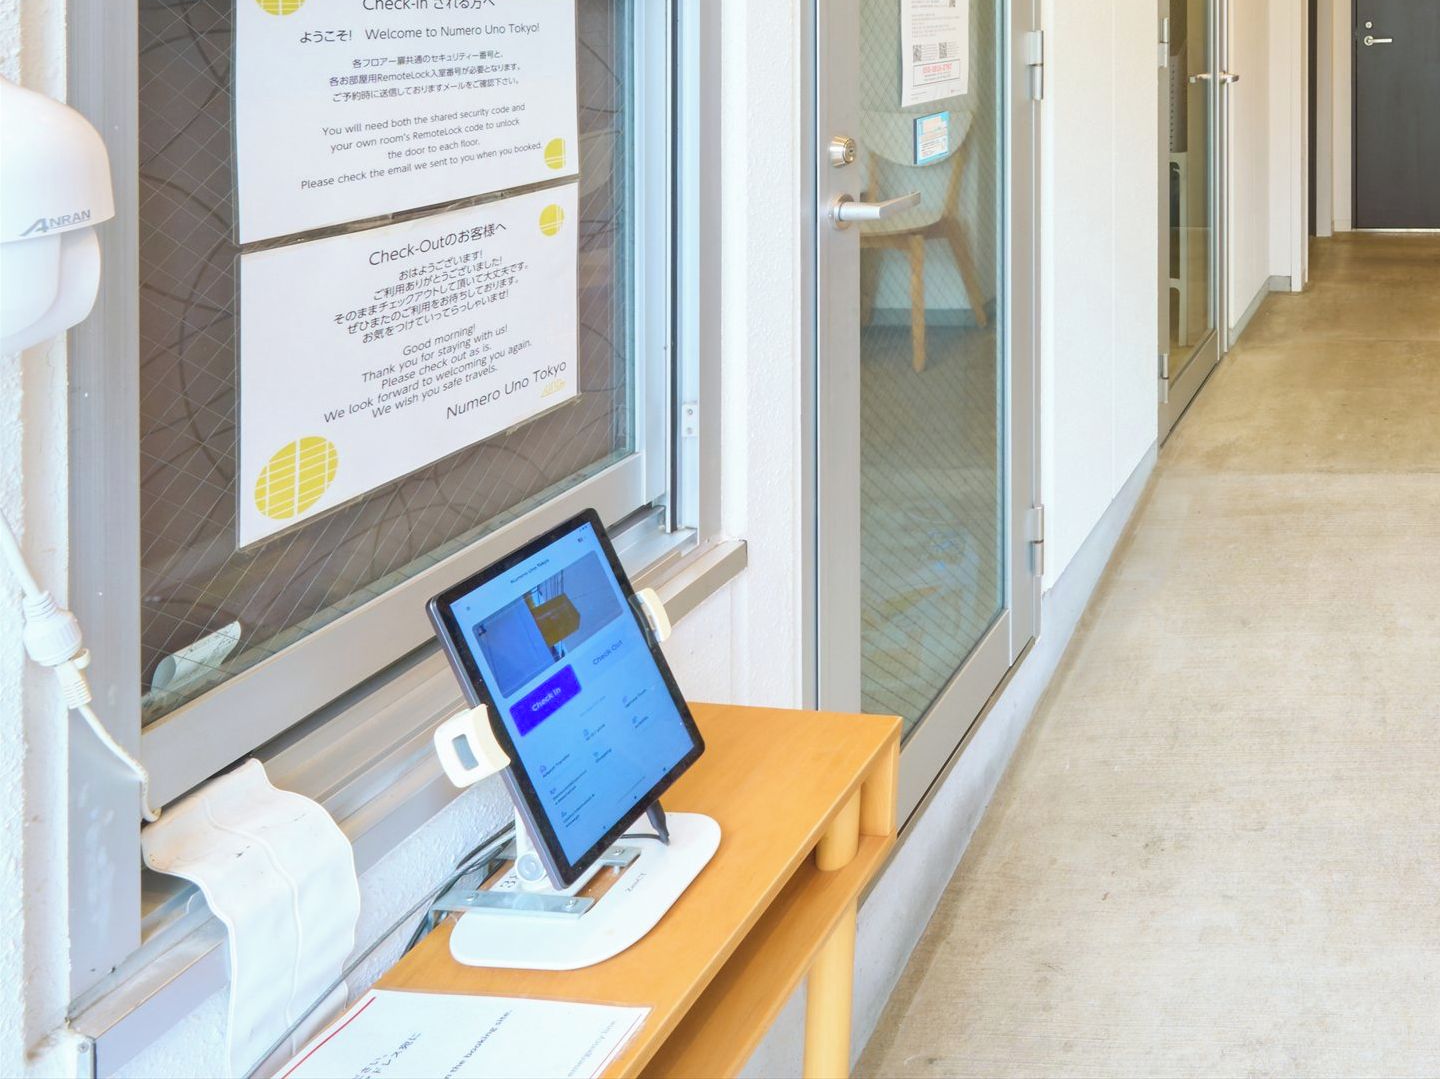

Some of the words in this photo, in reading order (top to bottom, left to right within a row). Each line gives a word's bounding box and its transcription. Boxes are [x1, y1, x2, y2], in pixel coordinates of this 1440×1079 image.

[300, 30, 351, 43] ようこそ!
[365, 28, 422, 39] Welcome
[426, 28, 437, 37] to
[441, 27, 482, 36] Numero
[485, 25, 505, 34] Uno
[509, 23, 539, 35] Tokyo!
[331, 142, 353, 153] your
[356, 139, 376, 148] own
[380, 133, 410, 144] room's
[413, 126, 463, 140] RemoteLock
[465, 124, 483, 134] code
[496, 118, 519, 127] unlock
[345, 123, 362, 133] will
[365, 120, 388, 130] need
[391, 118, 411, 127] both
[430, 112, 458, 122] shared
[459, 109, 489, 118] security
[491, 106, 509, 114] code
[512, 104, 525, 112] and
[301, 176, 335, 189] Please
[337, 171, 367, 183] check
[370, 169, 384, 178] the
[388, 164, 411, 175] email
[414, 162, 427, 170] we
[430, 158, 447, 167] sent
[460, 155, 474, 164] you
[476, 151, 497, 159] when
[499, 149, 512, 157] you
[514, 142, 541, 153] booked.
[388, 151, 402, 159] the
[405, 148, 425, 156] door
[439, 141, 458, 151] each
[461, 139, 480, 147] floor.
[18, 209, 92, 237] ANRAN
[399, 251, 482, 281] おはようございます!
[362, 364, 395, 382] Thank
[399, 357, 418, 372] you
[421, 352, 435, 362] for
[438, 338, 471, 358] staying
[474, 331, 493, 346] with
[496, 326, 507, 335] us!
[403, 338, 431, 356] Good
[435, 325, 475, 345] morning!
[324, 410, 345, 422] We
[349, 398, 373, 414] look
[378, 381, 419, 403] forward
[422, 377, 433, 387] to
[436, 357, 487, 381] welcoming
[489, 351, 505, 366] you
[508, 342, 531, 355] again.
[382, 371, 415, 389] Please
[419, 359, 448, 375] check
[451, 353, 466, 365] out
[469, 348, 479, 359] as
[372, 405, 391, 418] We
[395, 394, 418, 409] wish
[422, 386, 440, 401] you
[443, 378, 462, 391] safe
[465, 366, 497, 382] travels.
[447, 390, 500, 419] Numero
[505, 378, 529, 394] Uno
[534, 362, 566, 382] Tokyo
[531, 692, 554, 712] Check
[552, 687, 562, 698] In
[449, 1059, 466, 1073] the
[463, 1026, 499, 1058] booking
